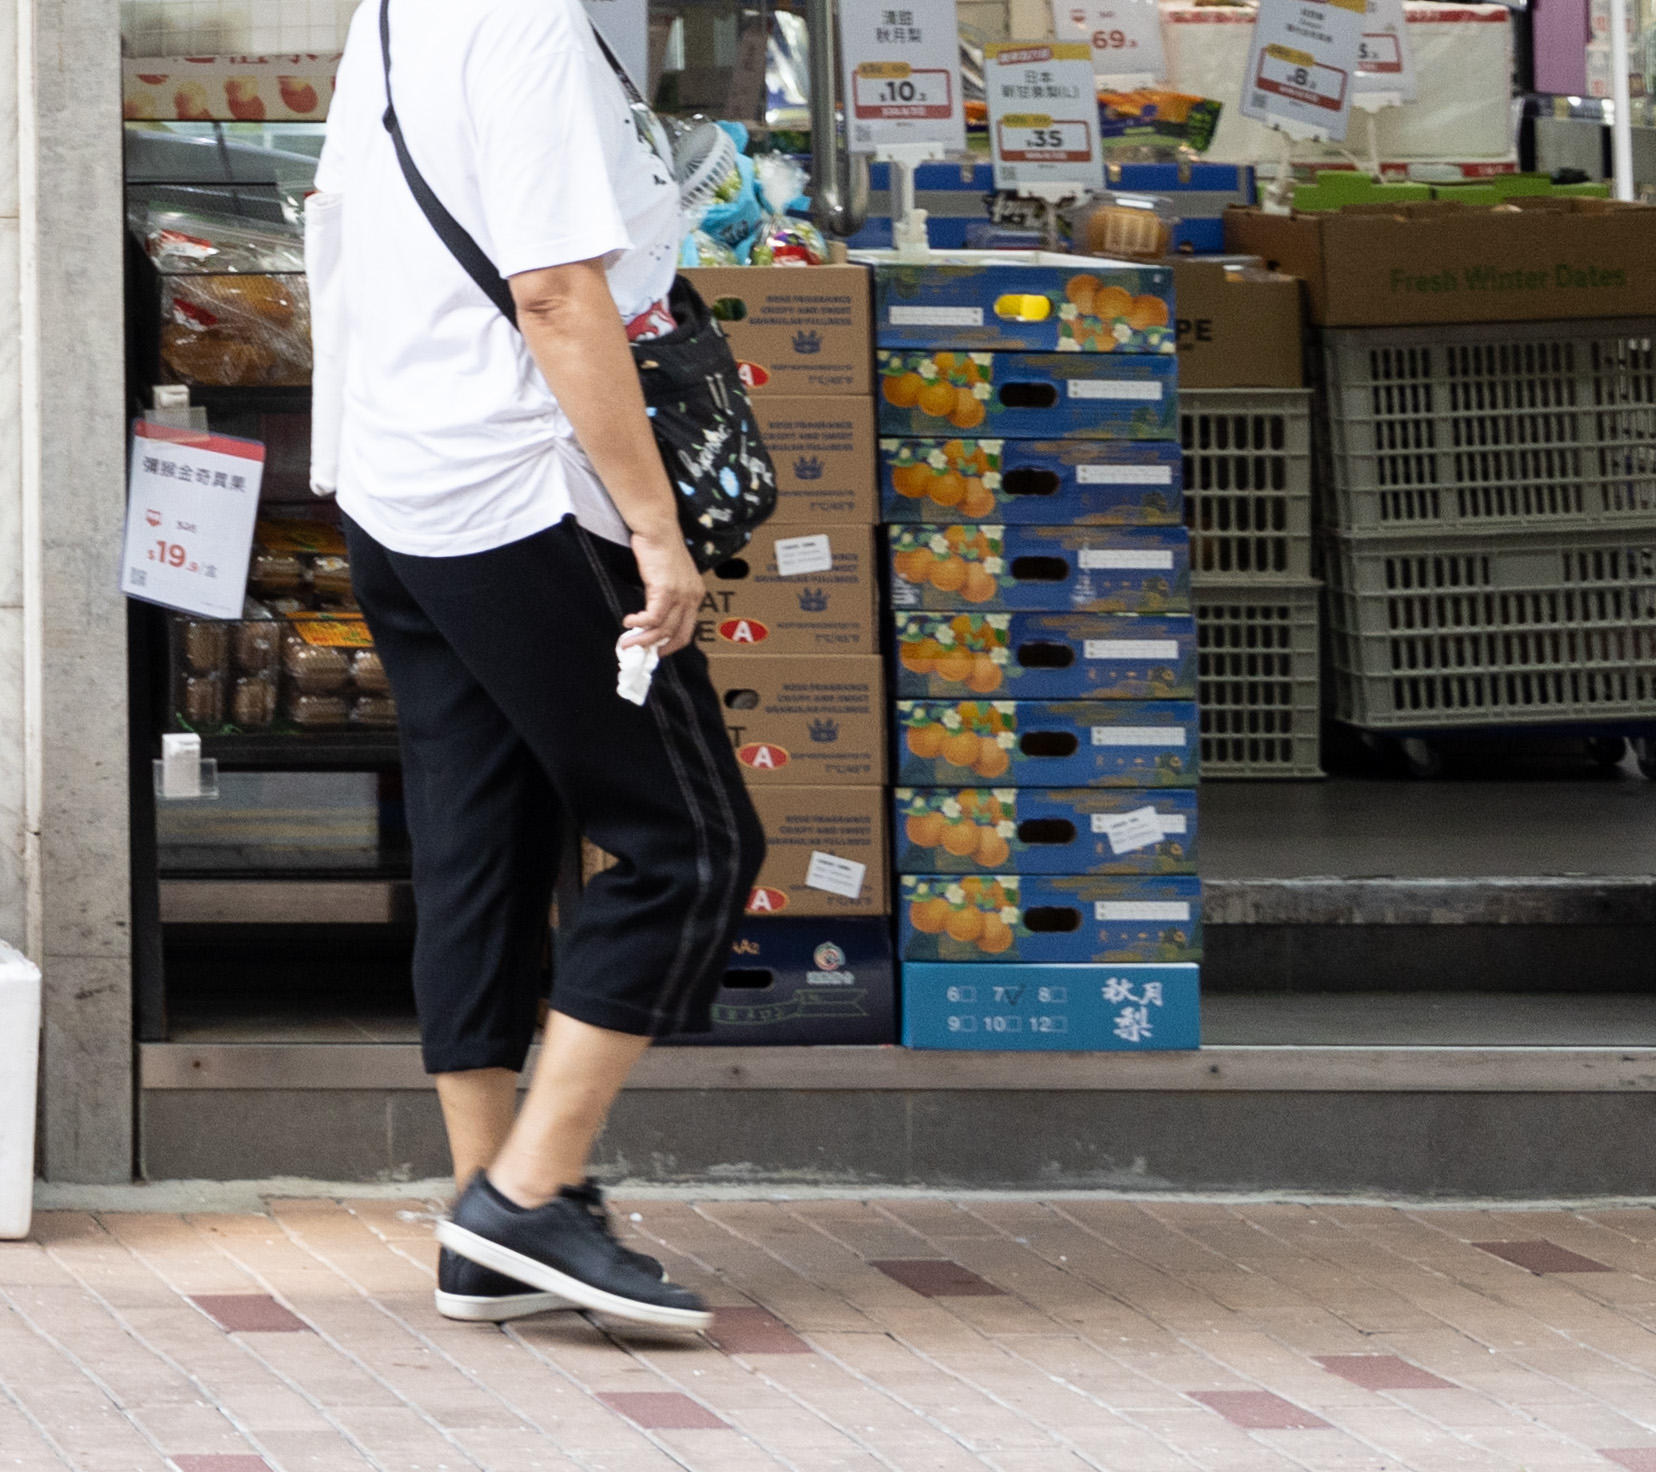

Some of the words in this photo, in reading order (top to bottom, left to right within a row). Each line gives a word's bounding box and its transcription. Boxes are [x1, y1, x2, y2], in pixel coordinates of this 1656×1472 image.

[1390, 266, 1460, 294] Fresh
[1466, 264, 1548, 292] Winter
[1550, 262, 1627, 292] Dates
